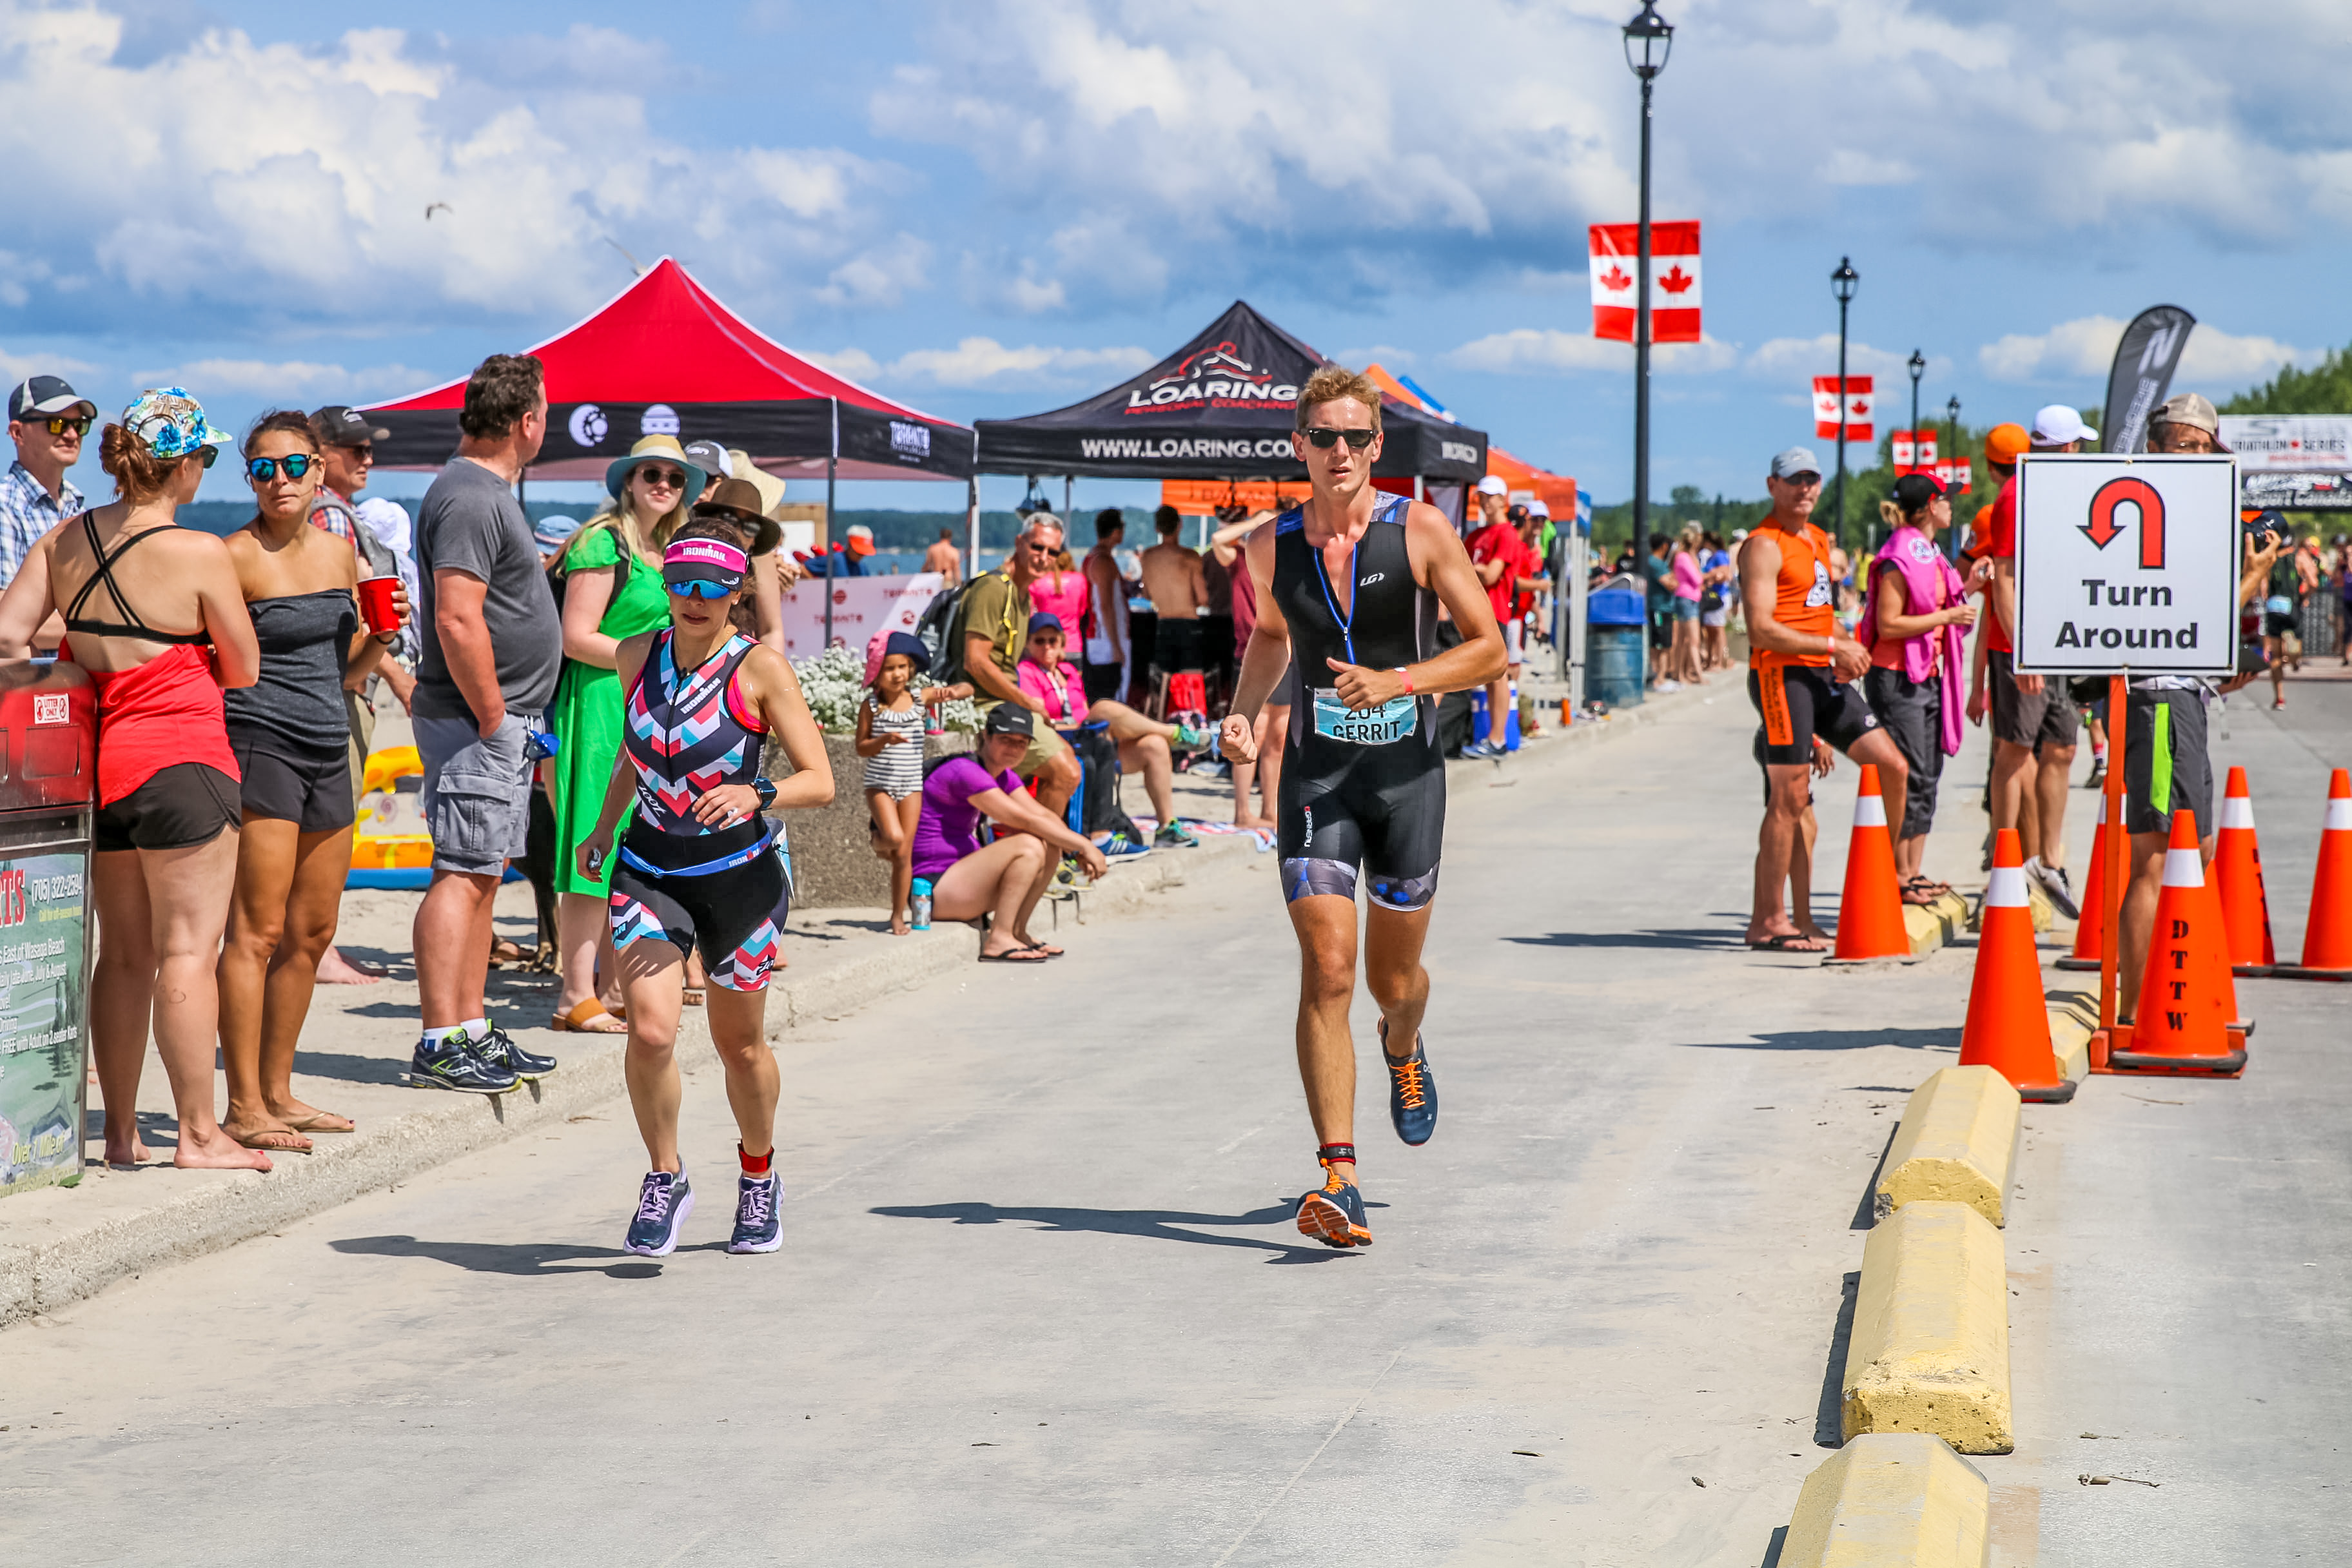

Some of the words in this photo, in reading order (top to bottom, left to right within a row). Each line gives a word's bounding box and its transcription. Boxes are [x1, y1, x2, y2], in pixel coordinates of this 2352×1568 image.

[1129, 380, 1298, 407] LOARING
[2231, 440, 2287, 451] TRIATHLON
[2303, 440, 2346, 451] SERIES
[683, 544, 727, 562] IRONMAN
[2082, 580, 2172, 606] Turn
[2055, 622, 2198, 649] Around
[680, 677, 721, 714] IRONMAN
[1333, 720, 1400, 741] GERRIT
[32, 877, 50, 906] (705)
[25, 941, 47, 961] Wasaga
[48, 936, 65, 956] Beach
[2, 1037, 16, 1054] FREE
[13, 1142, 31, 1166] Over
[39, 1133, 56, 1158] Mile
